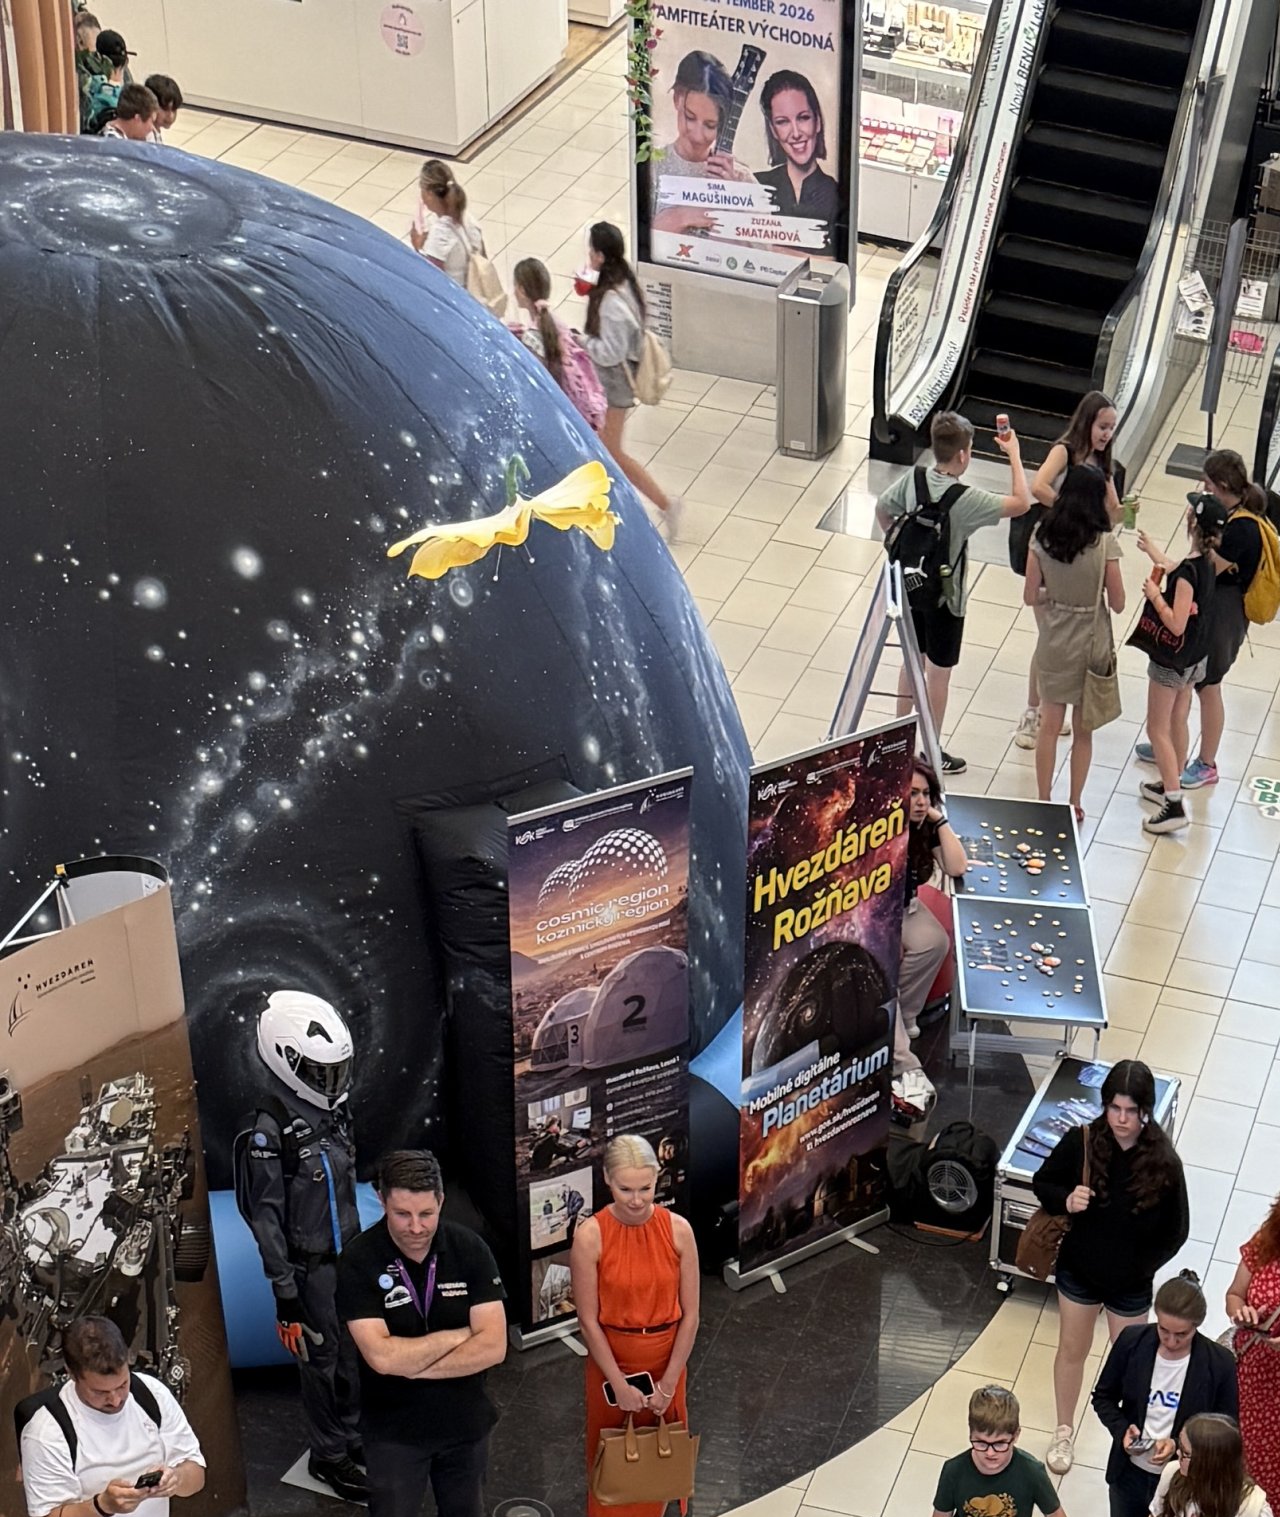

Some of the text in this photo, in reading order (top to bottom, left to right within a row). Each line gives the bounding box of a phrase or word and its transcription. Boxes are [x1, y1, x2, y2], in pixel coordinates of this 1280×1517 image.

[656, 5, 835, 52] AMFITEÁTER VÝCHODNÁ
[779, 3, 815, 22] 2026
[1017, 40, 1035, 80] BENU
[682, 190, 754, 207] MAGUŠINOVÁ
[707, 183, 726, 192] SIMA
[735, 226, 801, 243] SMATANOVÁ
[751, 217, 782, 228] ZUZANA
[753, 800, 905, 914] Hvezdáreň
[536, 884, 669, 931] cosmic region
[616, 898, 669, 918] region
[773, 862, 892, 951] Rožňava
[623, 995, 647, 1028] 2
[570, 1024, 579, 1043] 3
[749, 1052, 841, 1115] Mobilné digitálne
[762, 1045, 889, 1138] Planetárium
